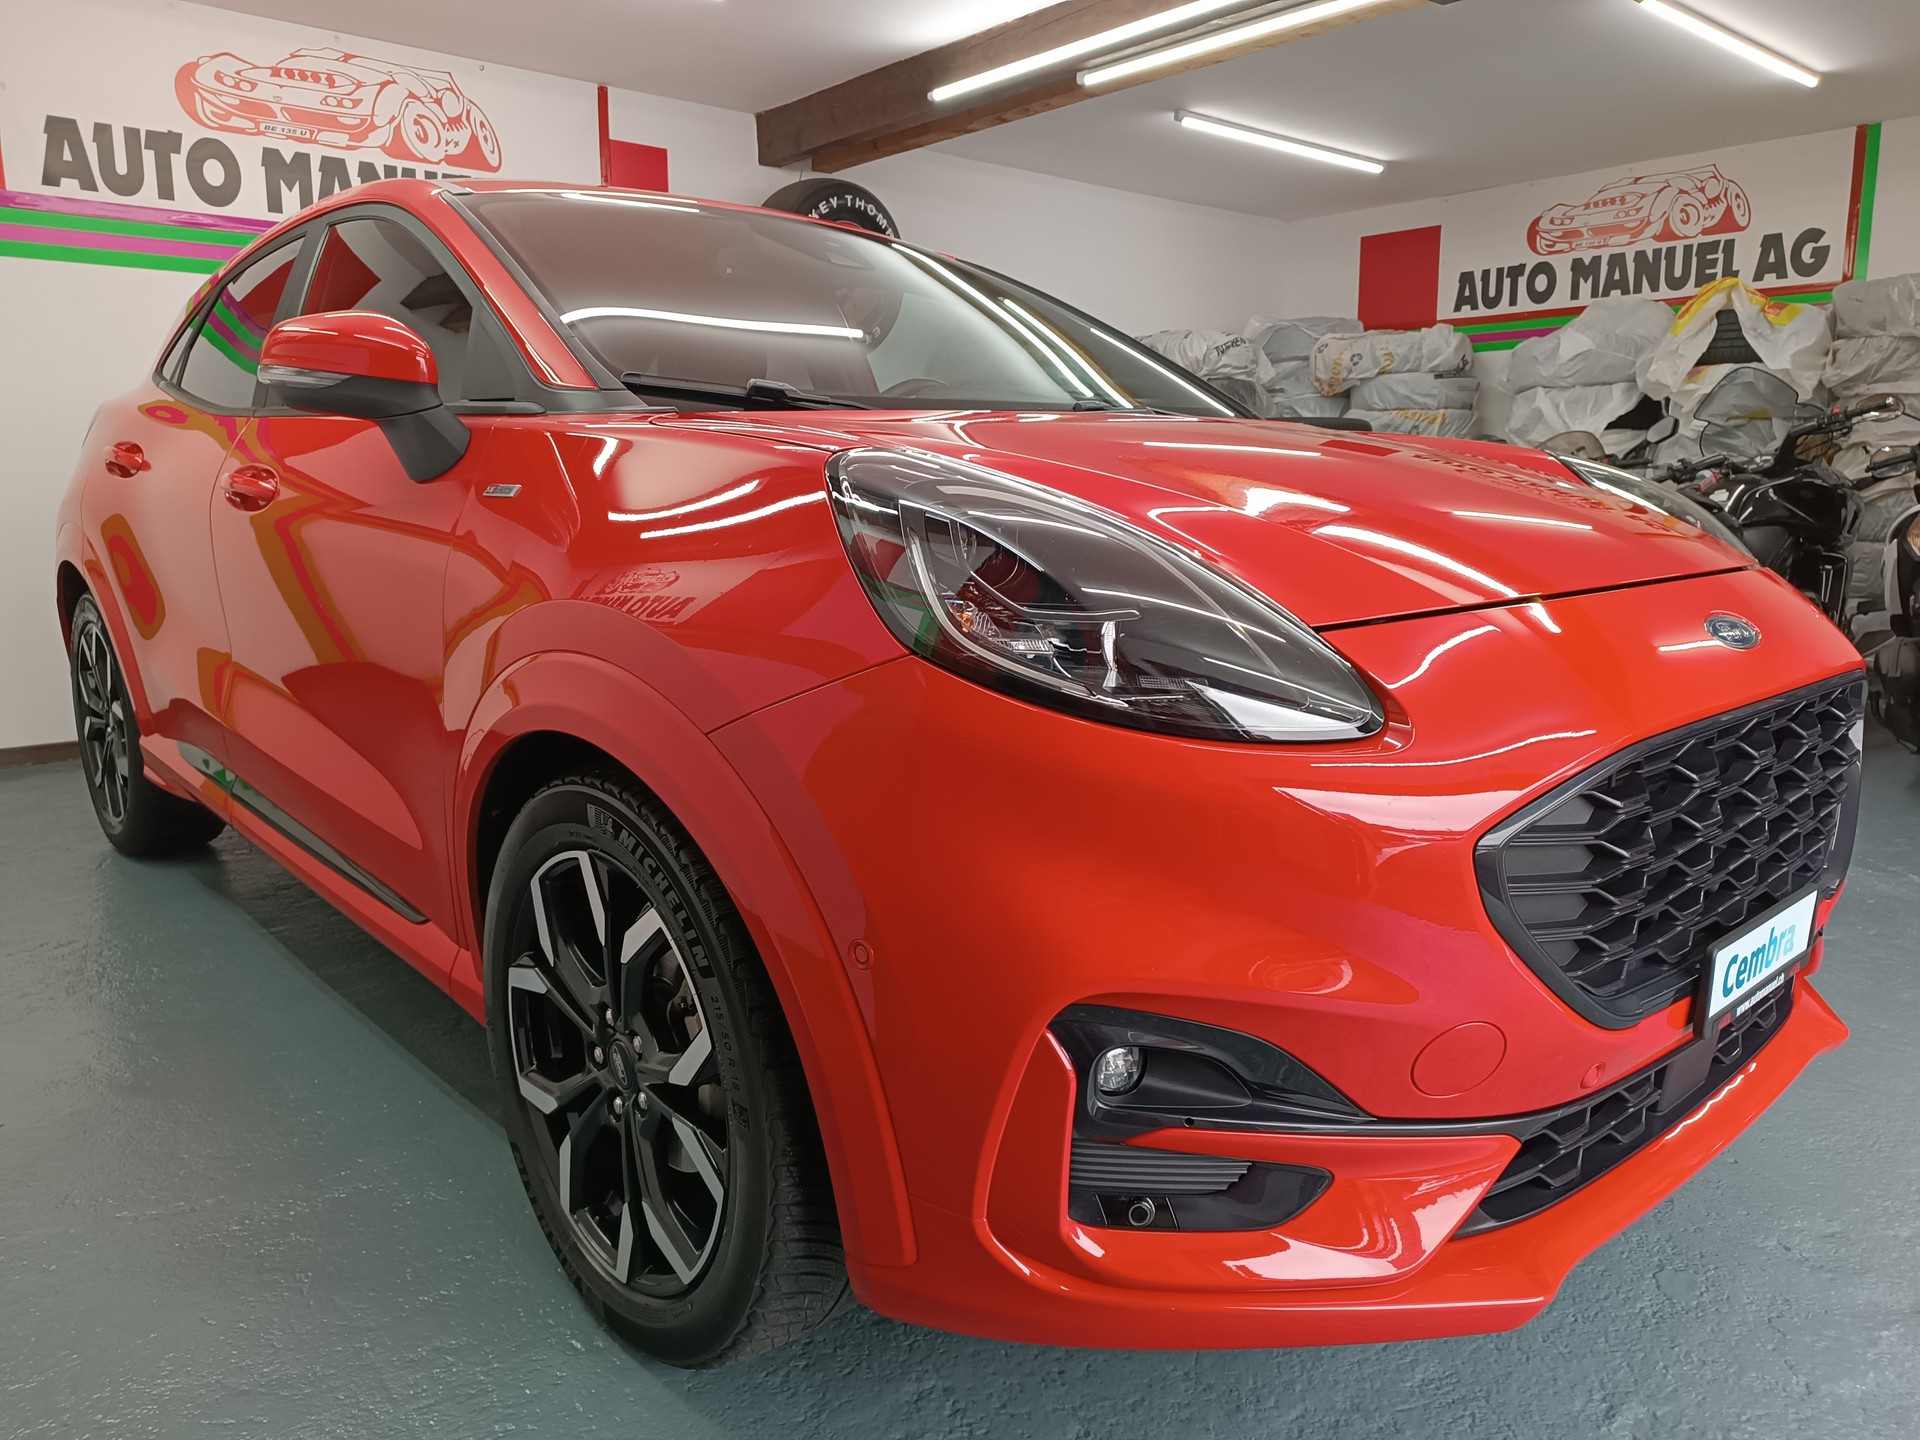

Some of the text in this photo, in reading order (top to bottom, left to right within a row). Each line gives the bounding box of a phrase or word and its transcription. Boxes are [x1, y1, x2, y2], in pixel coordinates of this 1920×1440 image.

[42, 115, 242, 208] AUTO
[1453, 227, 1831, 313] AUTO MANUEL AG
[617, 828, 710, 968] MICHELIN
[1722, 923, 1797, 999] Cembra
[710, 995, 733, 1052] 215/50
